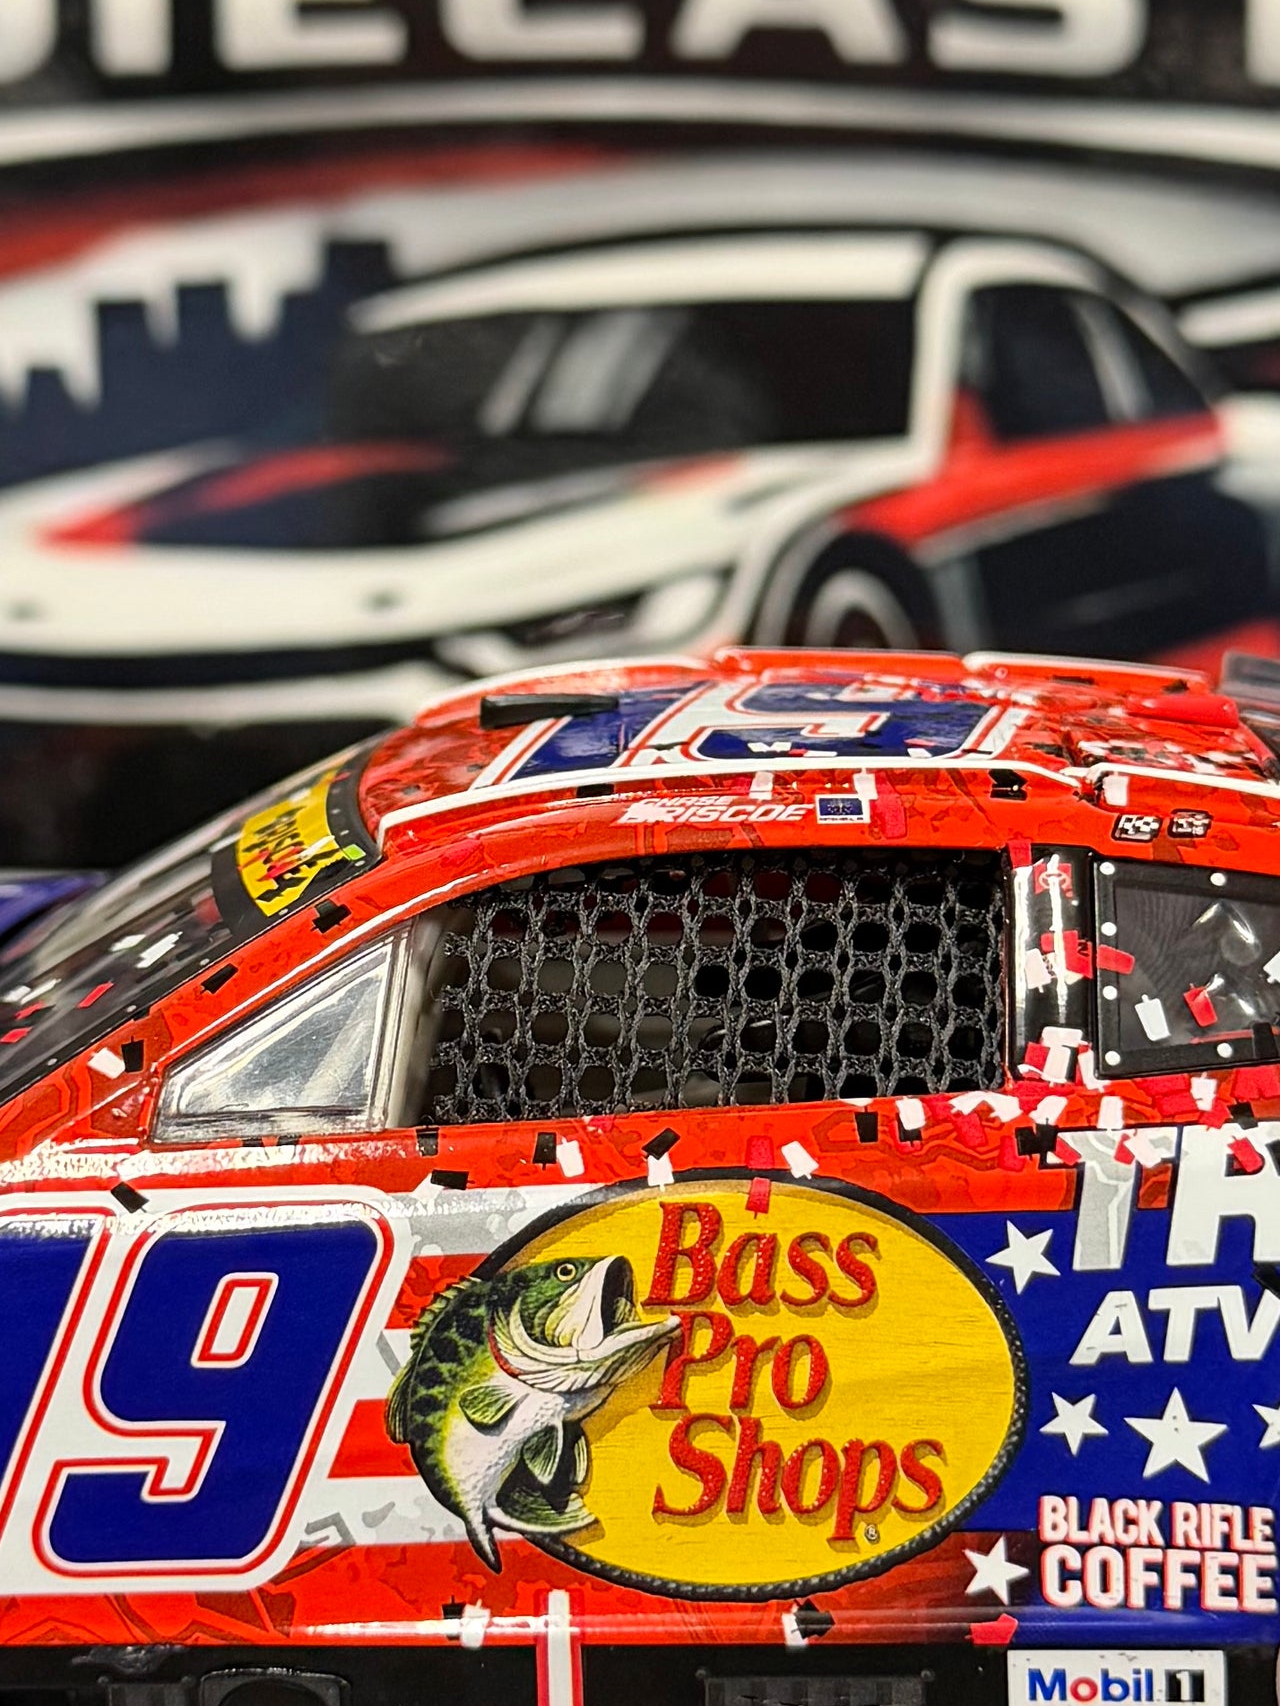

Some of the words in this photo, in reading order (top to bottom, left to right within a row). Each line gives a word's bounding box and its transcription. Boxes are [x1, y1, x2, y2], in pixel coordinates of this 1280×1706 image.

[644, 1200, 880, 1310] Bass
[657, 1311, 831, 1413] Pro
[652, 1412, 946, 1544] Shops
[1038, 1495, 1165, 1545] BLACK
[1171, 1501, 1276, 1553] RIFLE
[1040, 1543, 1280, 1613] COFFEE
[1027, 1668, 1154, 1703] Mobil
